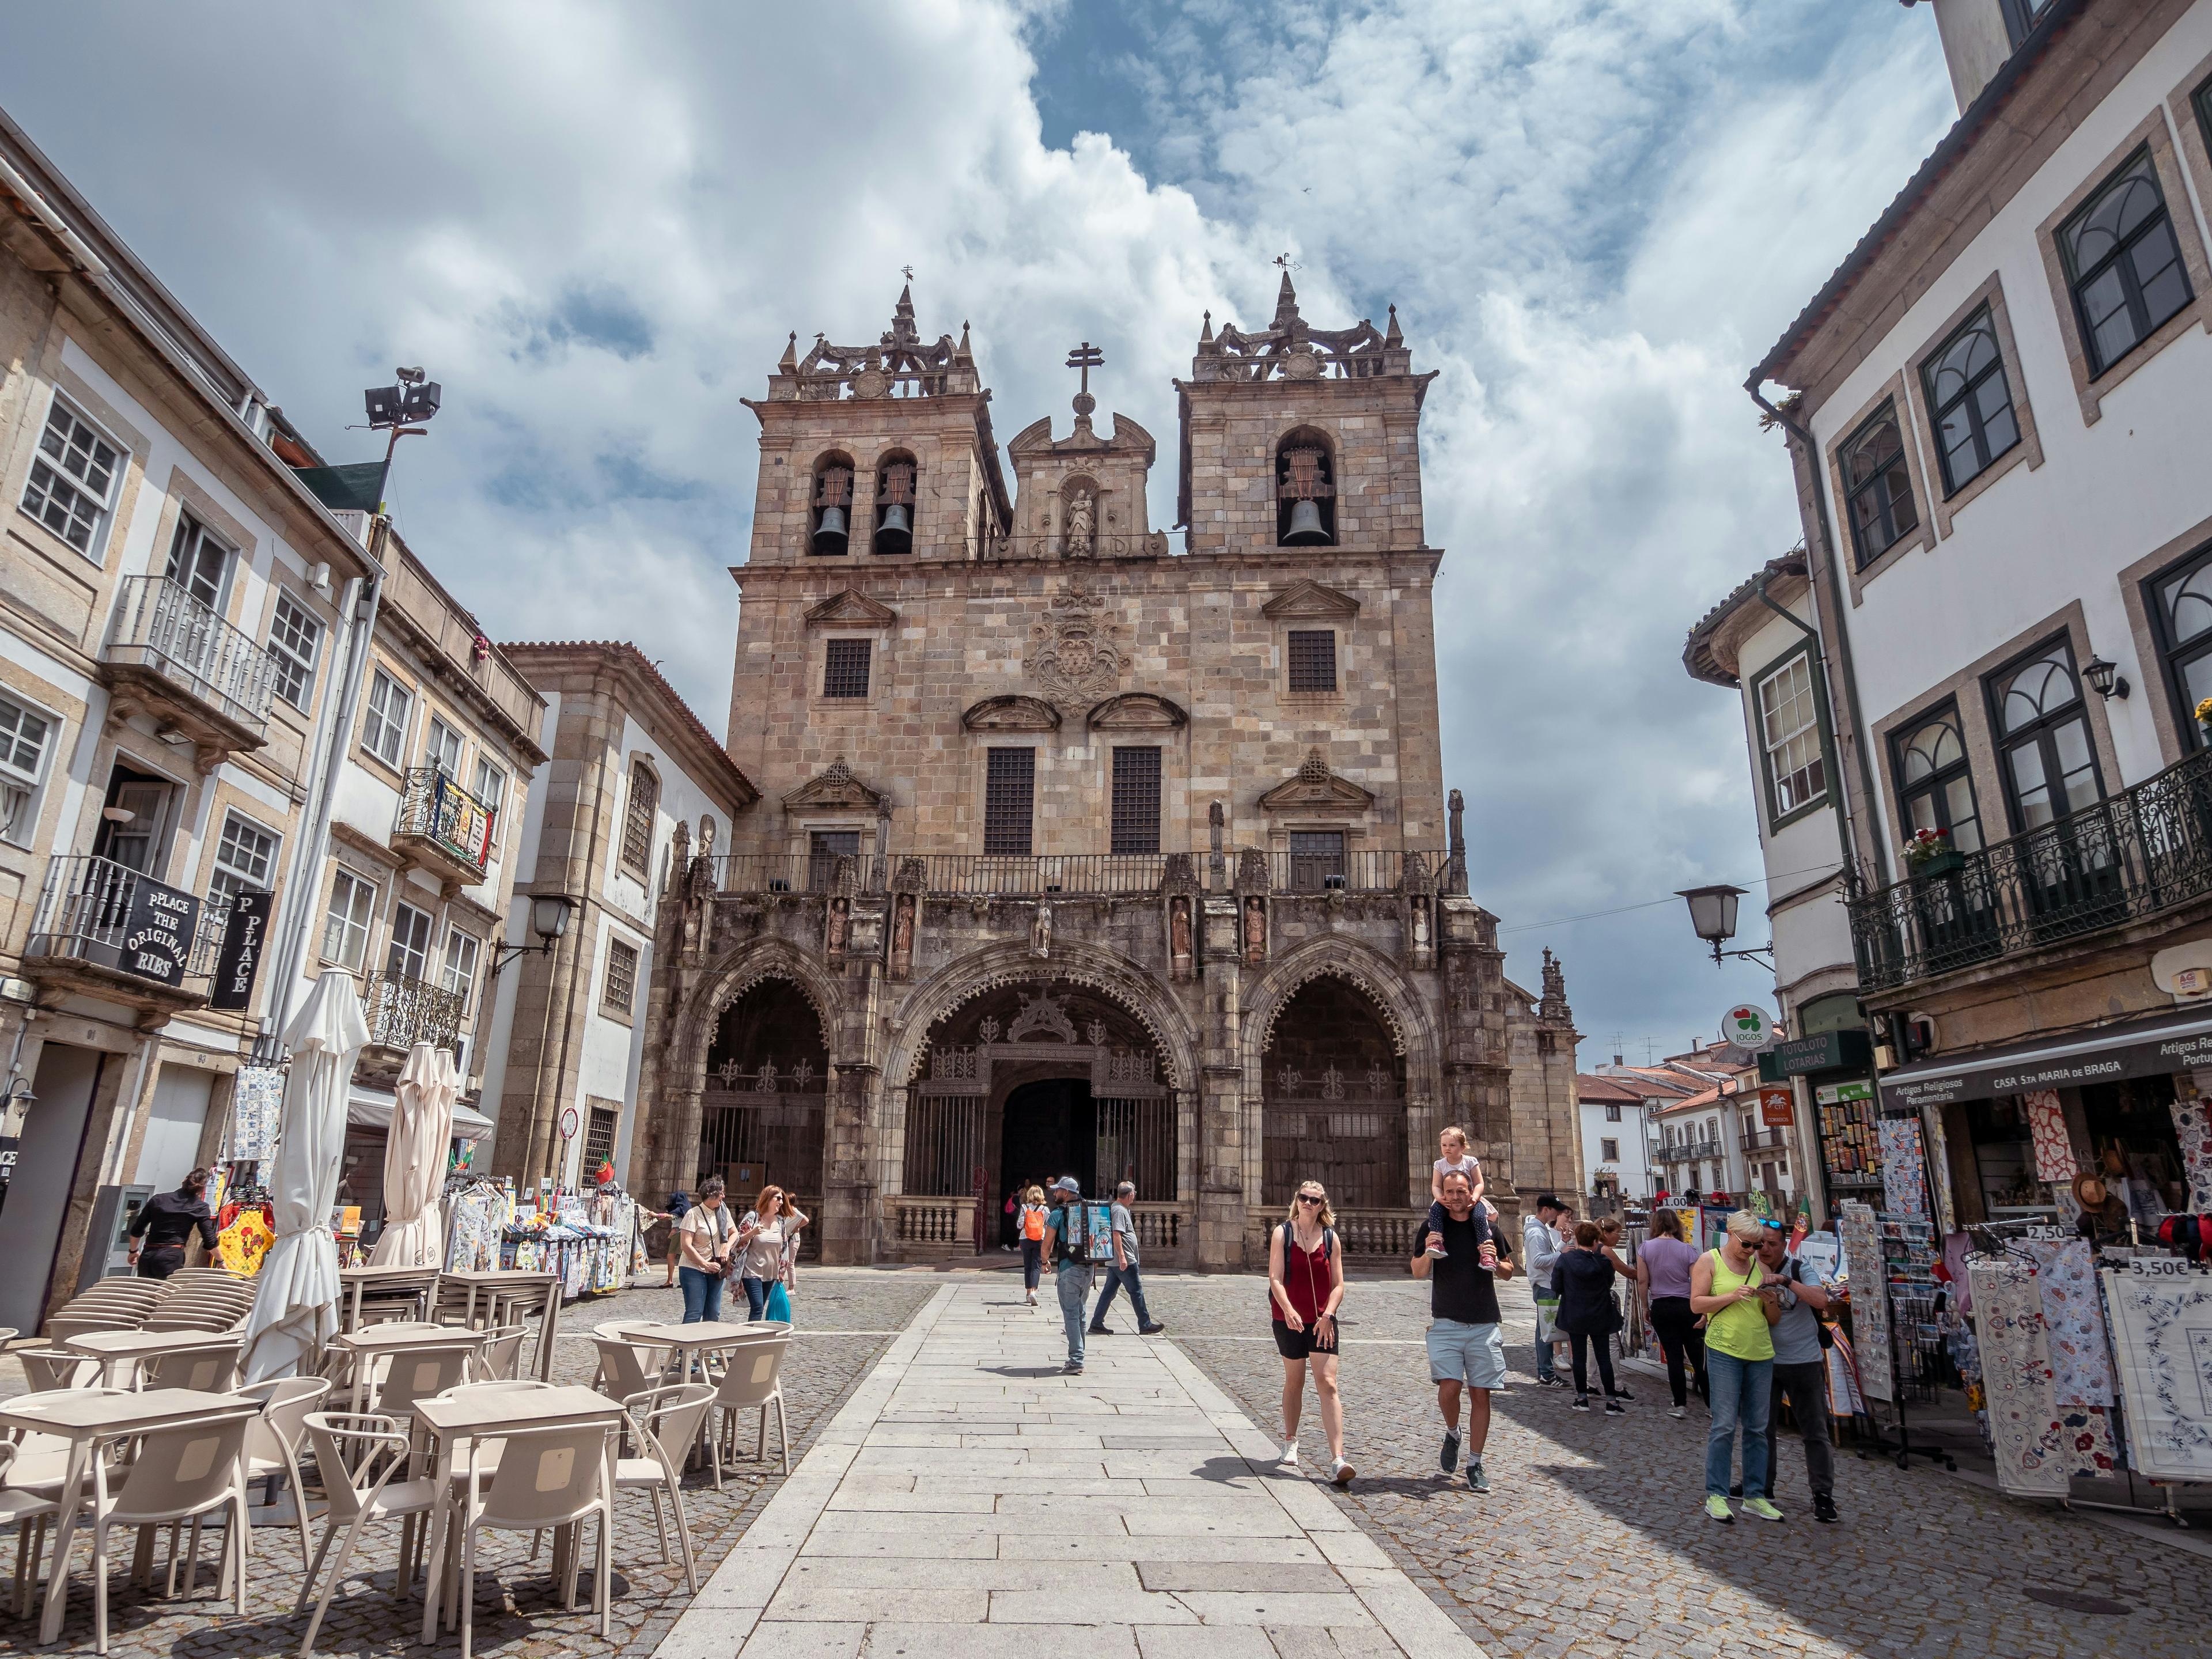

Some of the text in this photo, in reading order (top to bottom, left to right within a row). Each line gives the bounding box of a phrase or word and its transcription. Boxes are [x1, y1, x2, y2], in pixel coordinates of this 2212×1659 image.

[153, 911, 179, 931] THE
[127, 928, 187, 968] ORIGINAL
[135, 952, 172, 978] RIBS
[1736, 1033, 1763, 1043] JOGOS
[1782, 1037, 1827, 1056] TOTOLOTO
[2160, 1041, 2196, 1055] Artigos
[1783, 1053, 1825, 1070] LOTARIAS
[2183, 1053, 2212, 1066] Portu
[1994, 1077, 2018, 1089] CASA
[2038, 1069, 2071, 1082] MARIA
[2084, 1060, 2122, 1076] BRAGA
[1896, 1080, 1963, 1096] Artigos Religiosos
[1907, 1090, 1954, 1105] Paramentaria
[0, 1151, 18, 1166] CE
[1664, 1198, 1687, 1206] 1.00
[2028, 1226, 2066, 1241] 2,50
[2131, 1260, 2188, 1278] 3,50€
